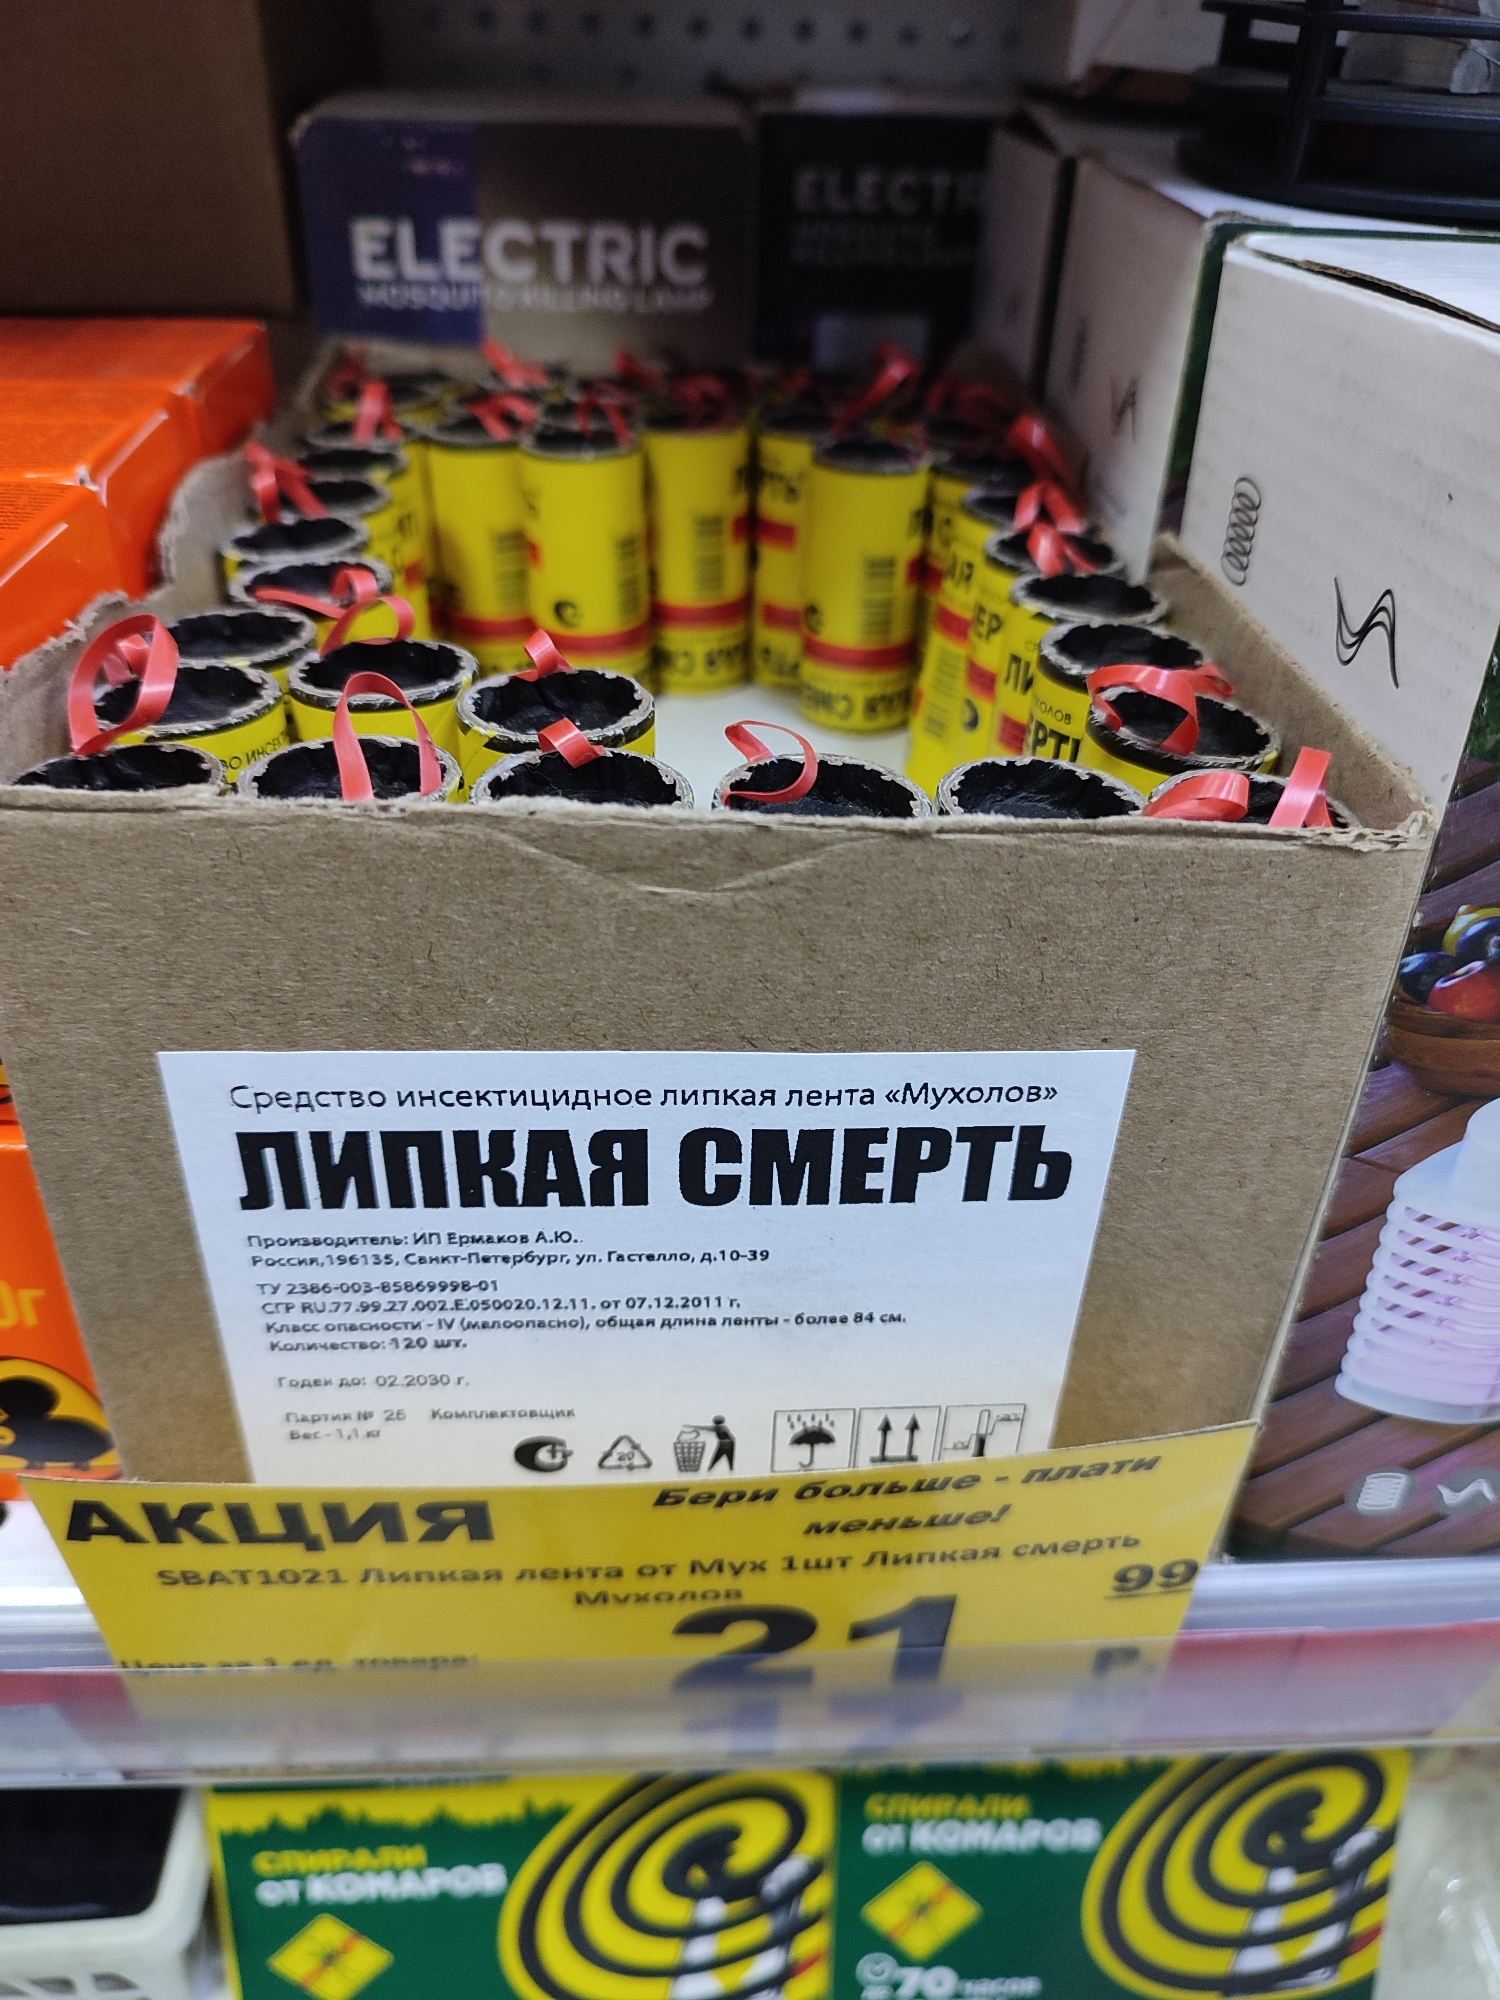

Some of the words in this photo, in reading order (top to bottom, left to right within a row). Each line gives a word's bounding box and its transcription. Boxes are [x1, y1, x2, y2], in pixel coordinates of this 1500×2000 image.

[349, 217, 709, 285] ELECTRIC
[230, 1085, 387, 1114] Средство
[399, 1087, 652, 1111] инсектицидное
[660, 1089, 776, 1107] липкая
[785, 1086, 876, 1108] лента
[885, 1082, 1058, 1110] «Мухолов»
[235, 1129, 649, 1210] ЛИПКАЯ
[679, 1124, 1073, 1206] СМЕРТЬ
[247, 1234, 410, 1250] Производитель:
[413, 1231, 442, 1245] ИП
[448, 1231, 529, 1248] Ермаков
[405, 1252, 572, 1269] Санкт-Петербург,
[576, 1251, 603, 1265] ул.
[607, 1249, 696, 1265] Гастелло,
[700, 1248, 770, 1265] д.10-39
[256, 1282, 281, 1296] ТУ
[287, 1279, 498, 1295] 2386-003-85869998-01
[261, 1301, 295, 1314] СГР
[601, 1299, 622, 1310] от
[626, 1296, 722, 1310] 07.12.2011
[266, 1320, 321, 1334] Класс
[324, 1320, 421, 1333] опасности
[438, 1318, 454, 1331] IV
[460, 1317, 590, 1332] (малоопасно),
[596, 1316, 656, 1330] общая
[660, 1315, 717, 1329] длина
[721, 1315, 779, 1327] ленты
[795, 1312, 849, 1325] более
[853, 1311, 875, 1324] 84
[879, 1313, 907, 1325] см.
[270, 1339, 387, 1353] Количество:
[434, 1338, 468, 1349] шт.
[278, 1376, 333, 1388] Годен
[339, 1376, 366, 1387] до:
[375, 1374, 451, 1387] 02.2030
[456, 1376, 470, 1387] г.
[285, 1410, 354, 1424] Партия
[358, 1410, 375, 1422] №
[431, 1407, 576, 1420] Комплектовщик
[289, 1430, 320, 1440] Вес
[652, 1486, 779, 1510] Бери
[794, 1471, 982, 1502] больше
[1020, 1455, 1163, 1486] плати
[66, 1500, 496, 1551] АКЦИЯ
[803, 1503, 1013, 1537] меньше!
[157, 1567, 347, 1588] SBAT1021
[360, 1567, 502, 1585] Липкая
[516, 1564, 625, 1582] лента
[635, 1560, 678, 1577] от
[690, 1557, 768, 1580] Мух
[781, 1551, 853, 1572] 1шт
[860, 1542, 1002, 1568] Липкая
[1012, 1534, 1141, 1562] смерть
[1111, 1558, 1201, 1593] 99
[574, 1585, 744, 1608] Мухолов
[672, 1595, 959, 1696] 21
[864, 1792, 1031, 1823] СПИРАЛИ
[862, 1824, 905, 1856] ОТ
[908, 1817, 1102, 1854] КОМАРОВ
[253, 1844, 427, 1876] СПИРАЛИ
[256, 1878, 299, 1906] ОТ
[306, 1862, 508, 1904] КОМАРОВ
[894, 1965, 959, 2000] 70
